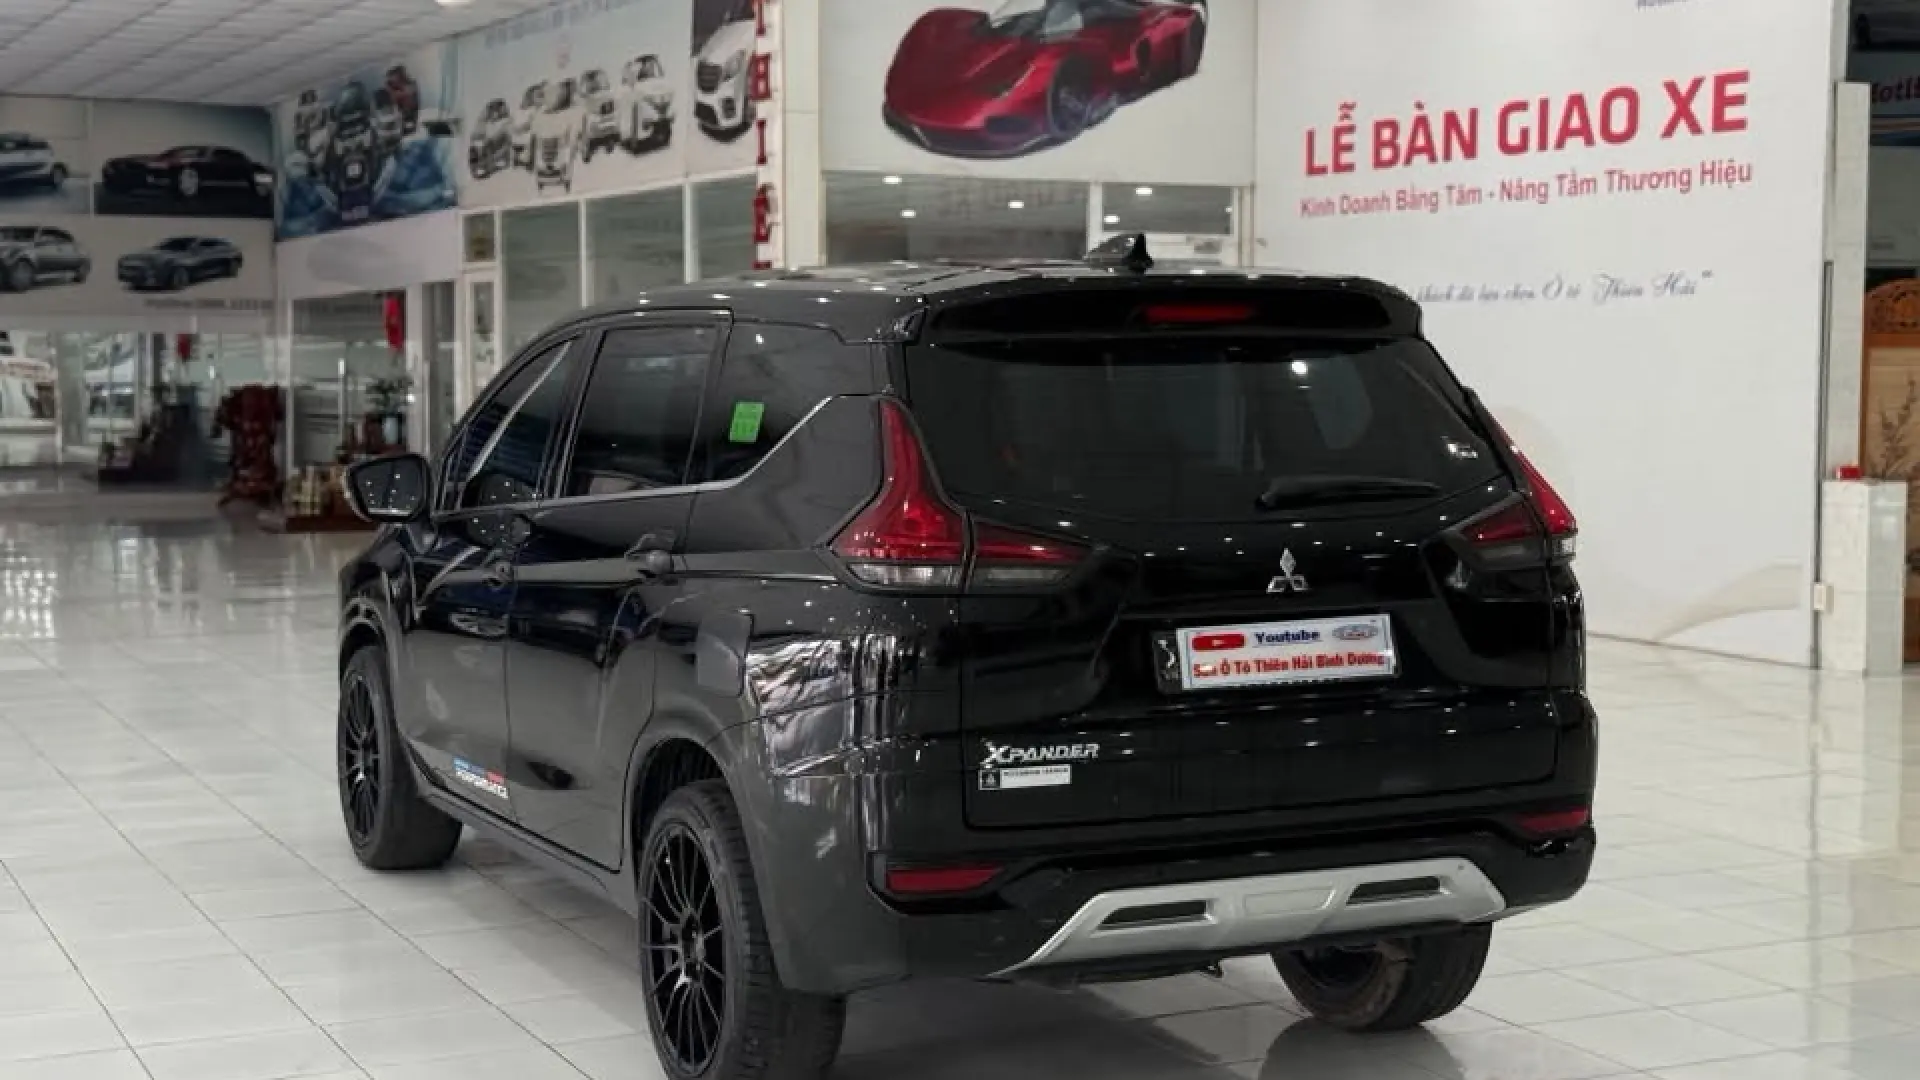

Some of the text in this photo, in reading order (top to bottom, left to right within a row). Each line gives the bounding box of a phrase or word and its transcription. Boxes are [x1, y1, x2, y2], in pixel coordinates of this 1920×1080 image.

[1305, 70, 1750, 176] LỄ BÀN GIAO XE
[1301, 196, 1335, 217] Kinh
[1339, 189, 1391, 214] Doanh
[1700, 157, 1753, 188] Hiệu
[1255, 630, 1320, 644] Youtube
[980, 740, 1100, 769] XPANDER
